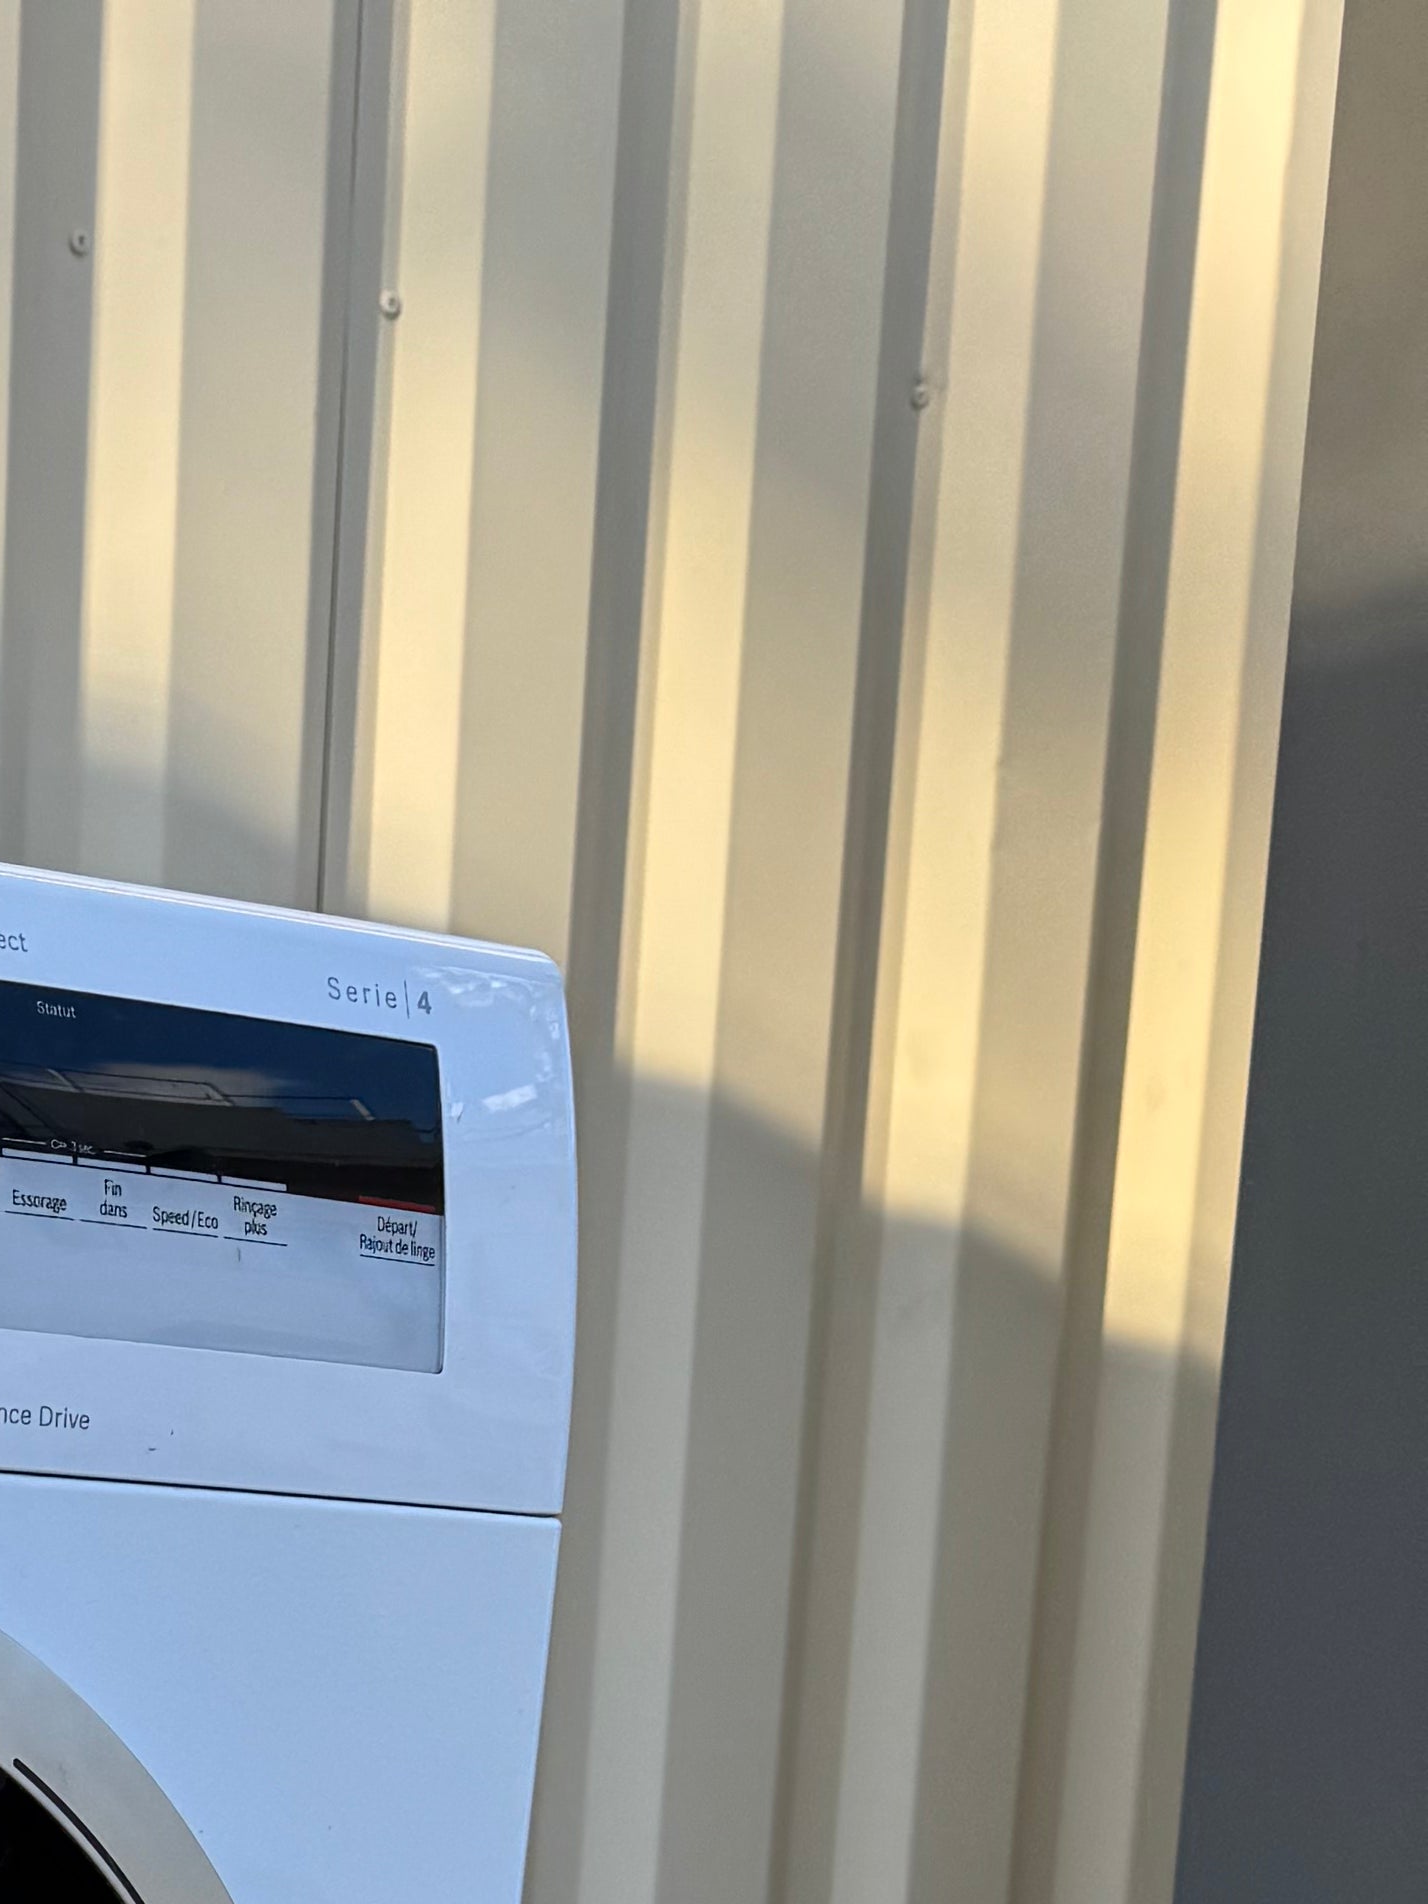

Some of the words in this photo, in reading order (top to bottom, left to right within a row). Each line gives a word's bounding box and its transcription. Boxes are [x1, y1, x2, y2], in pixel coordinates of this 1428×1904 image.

[325, 976, 398, 1010] Serie
[36, 1000, 77, 1020] Statut
[103, 1179, 122, 1198] Fin
[12, 1189, 67, 1214] Essorage
[99, 1202, 128, 1218] dans
[233, 1195, 277, 1219] Rinçage
[244, 1219, 268, 1237] plus
[377, 1215, 418, 1238] Départ/
[360, 1234, 394, 1256] Rajout
[395, 1241, 409, 1255] de
[410, 1241, 436, 1260] linge
[39, 1405, 91, 1431] Drive
